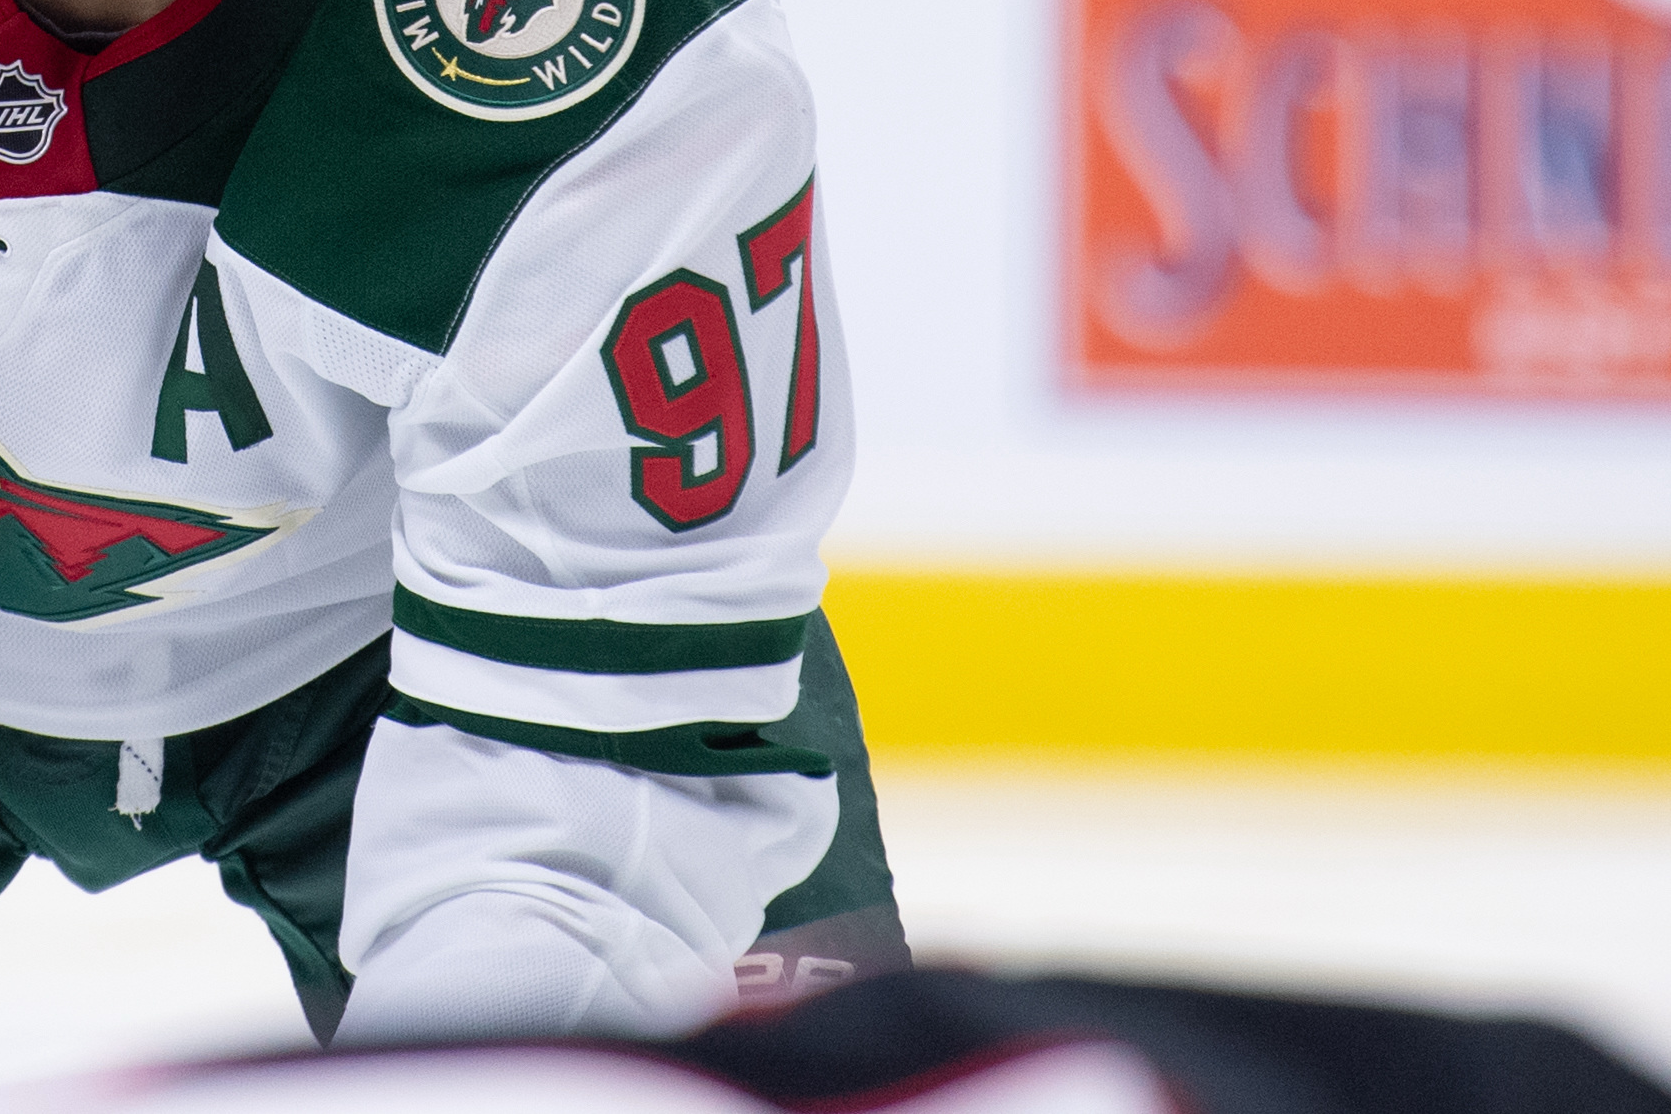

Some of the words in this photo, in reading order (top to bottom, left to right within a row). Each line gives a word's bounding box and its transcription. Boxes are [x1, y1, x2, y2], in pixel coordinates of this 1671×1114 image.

[531, 1, 622, 92] WILD
[150, 254, 274, 464] A
[600, 163, 821, 534] 97
